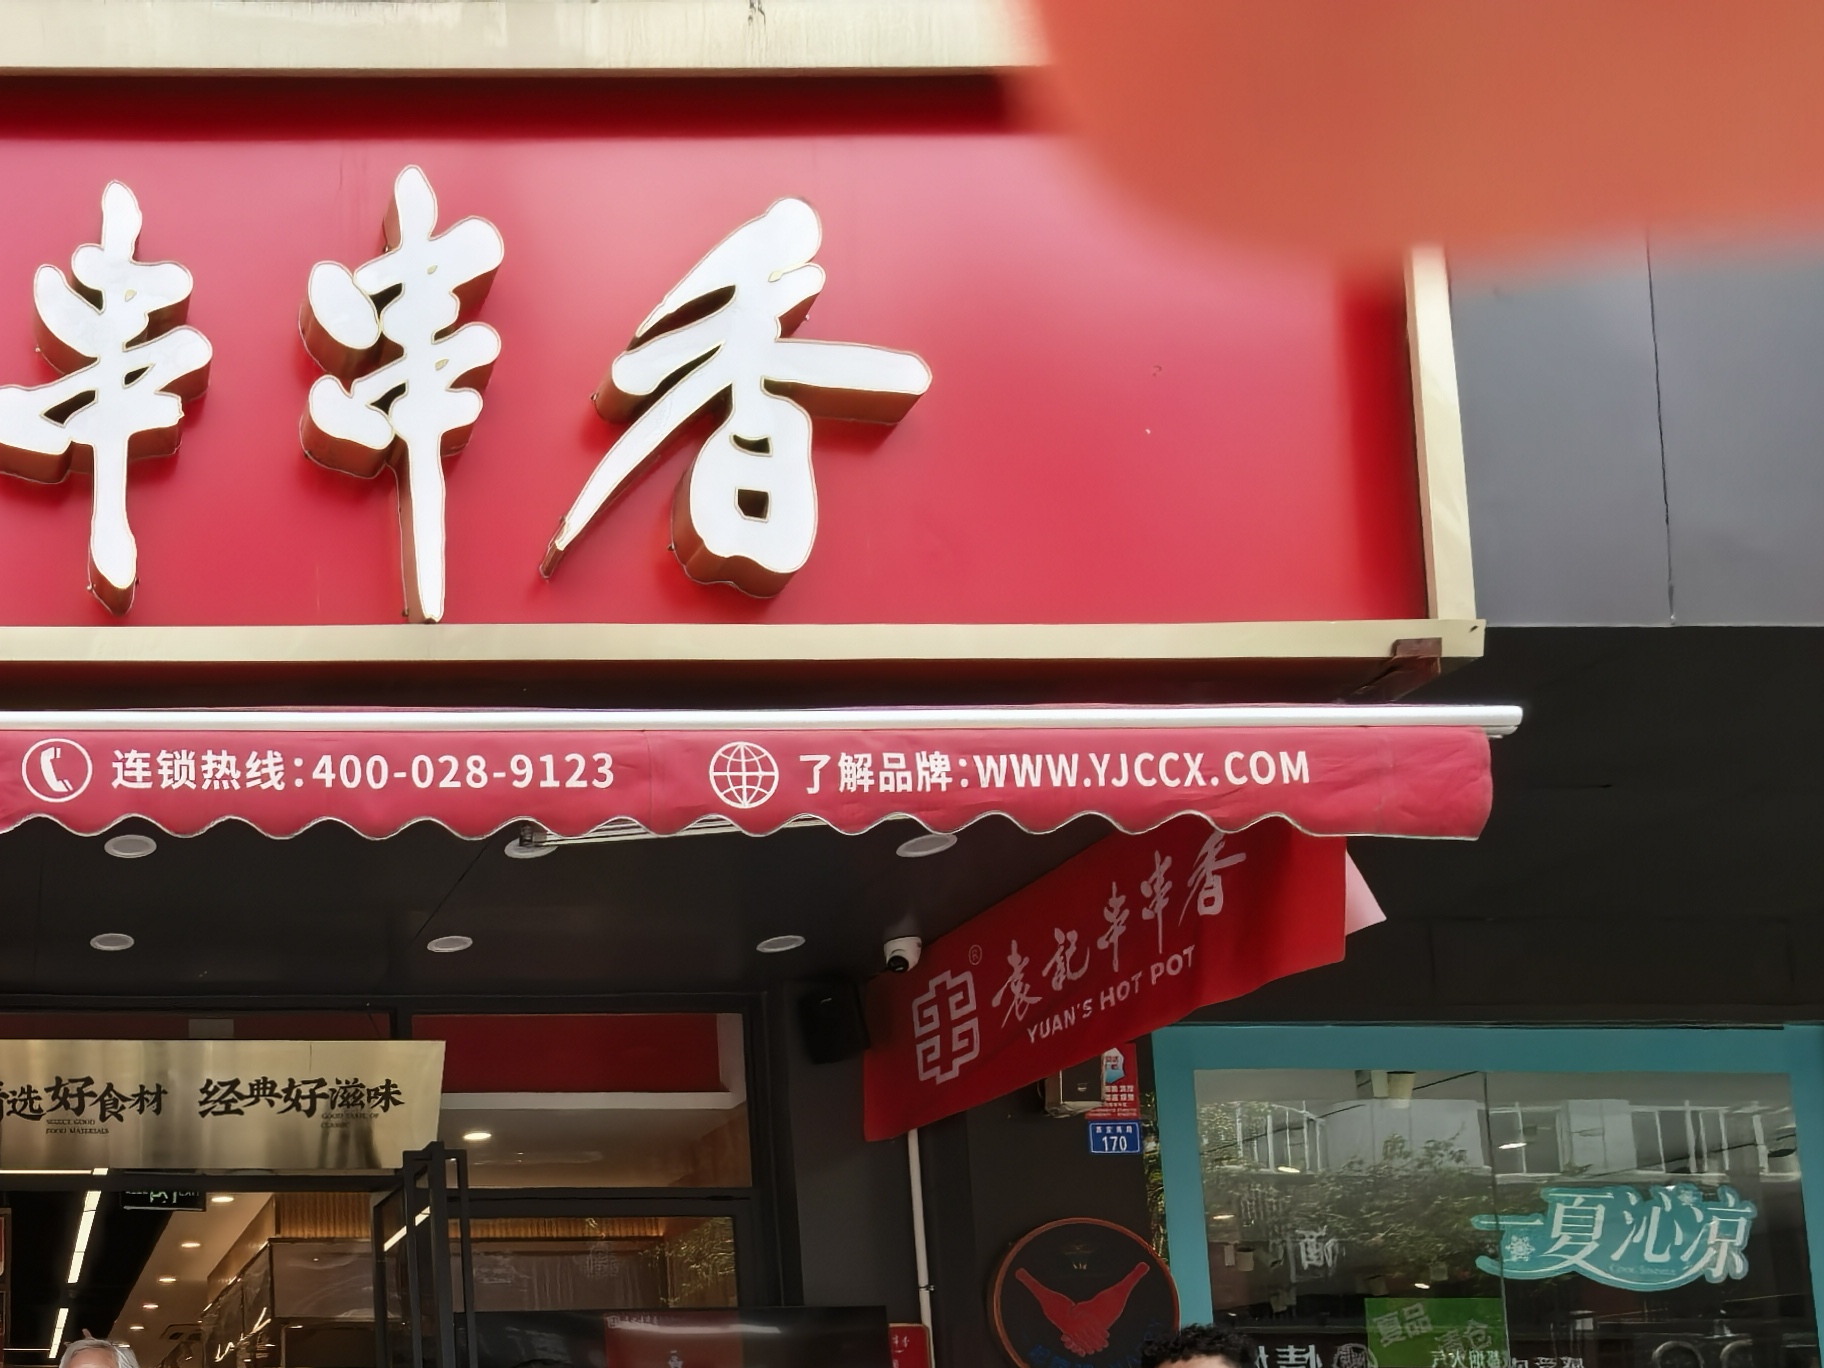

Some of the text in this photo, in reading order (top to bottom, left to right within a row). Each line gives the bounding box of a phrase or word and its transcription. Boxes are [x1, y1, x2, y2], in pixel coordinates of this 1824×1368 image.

[1026, 945, 1196, 1044] YUAN'S HOT POT
[197, 1076, 406, 1119] 经典好滋味
[1102, 1135, 1128, 1152] 170
